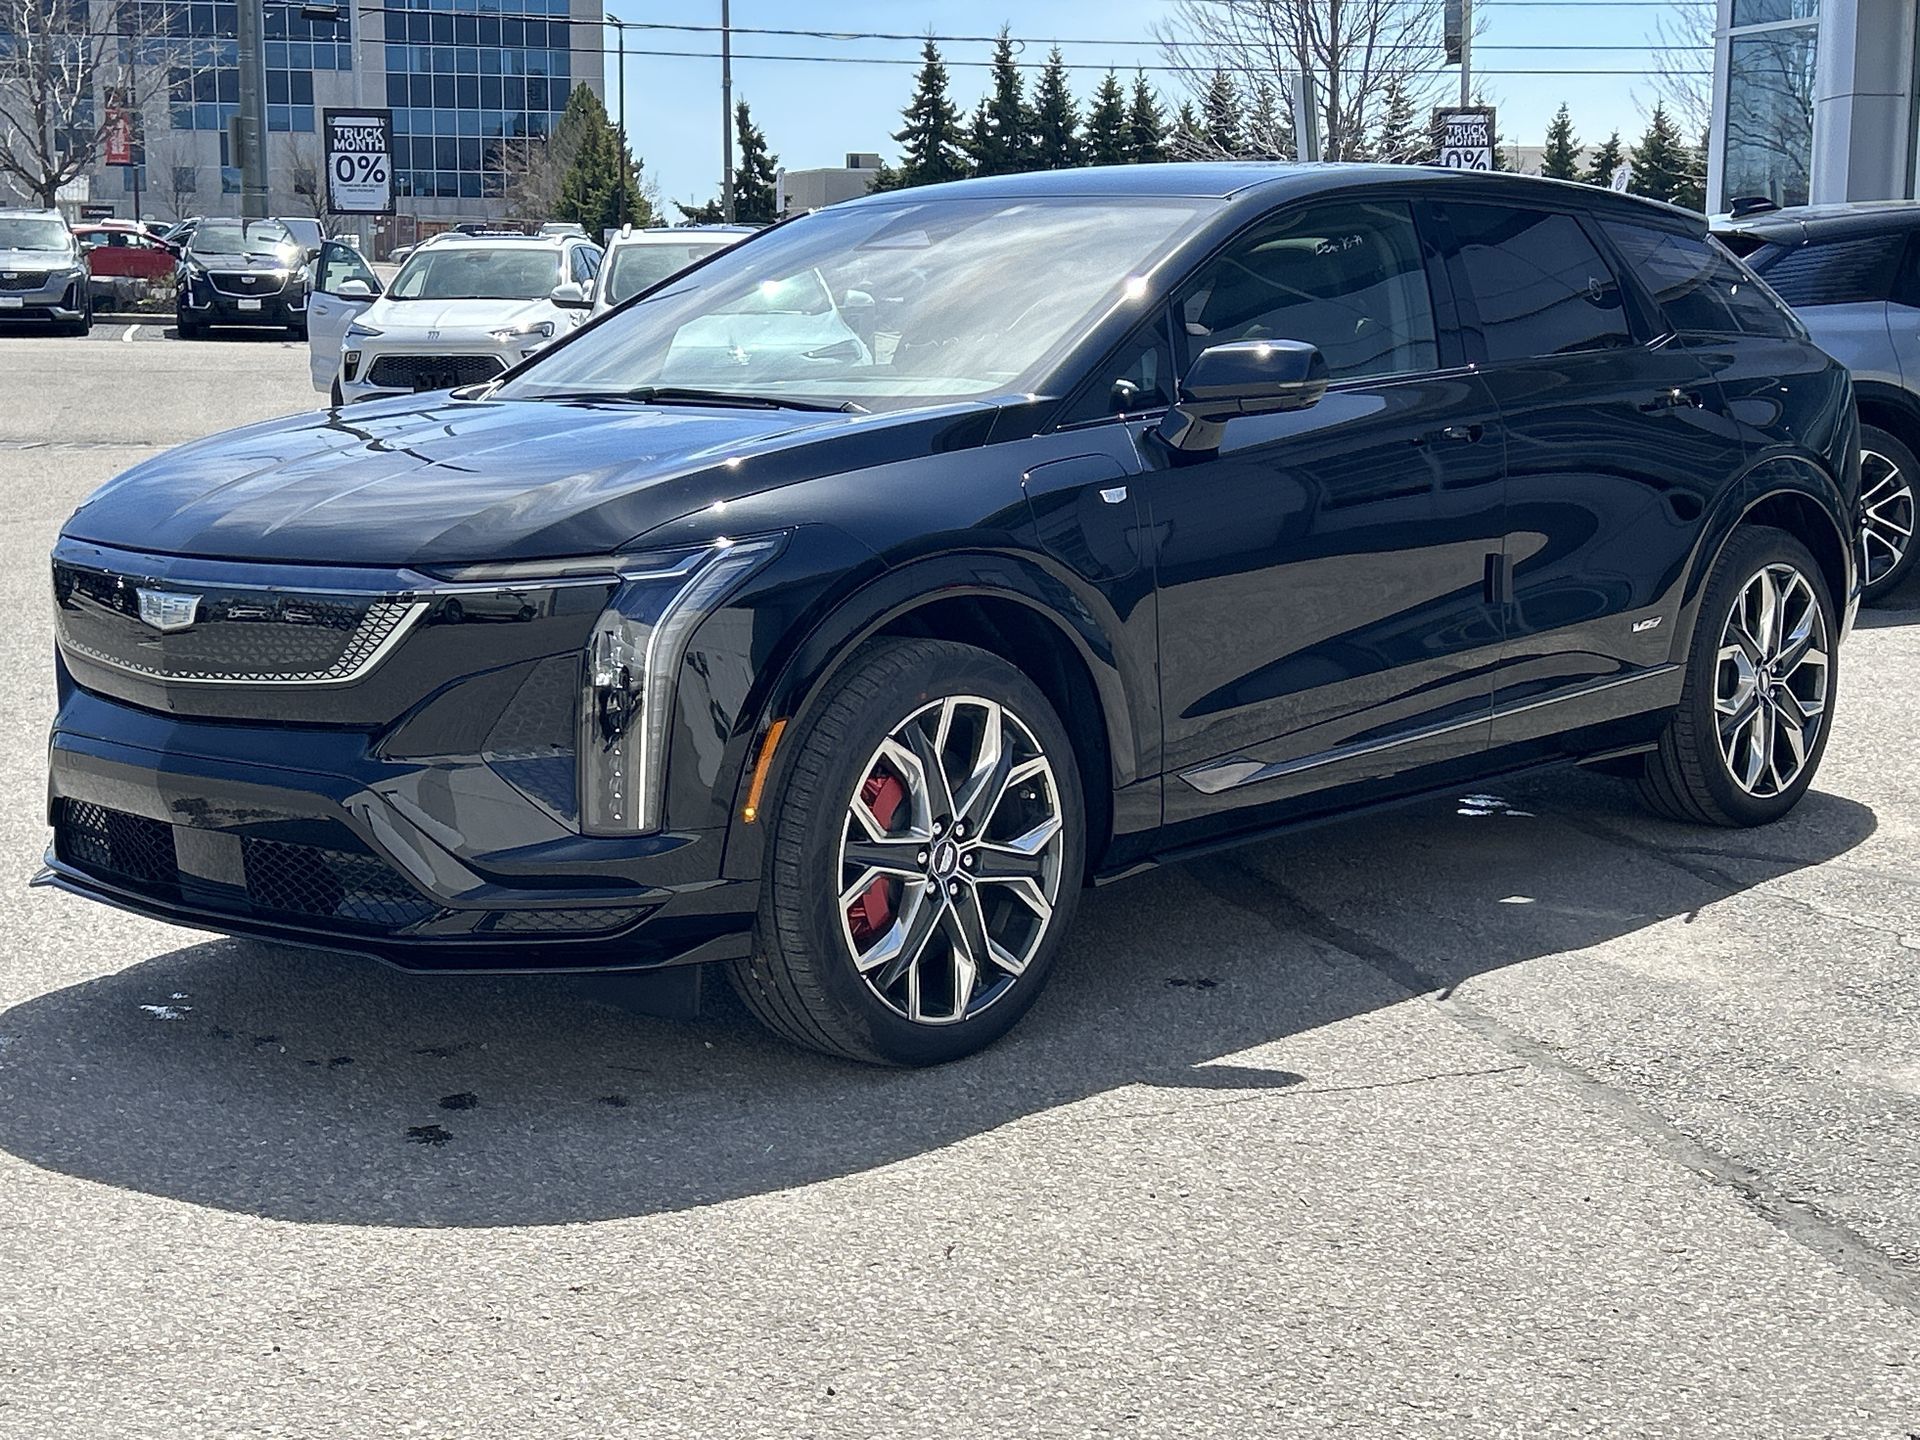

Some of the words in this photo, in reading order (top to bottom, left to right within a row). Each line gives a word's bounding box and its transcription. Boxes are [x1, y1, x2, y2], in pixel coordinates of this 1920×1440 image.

[334, 128, 383, 139] TRUCK
[1446, 124, 1487, 135] TRUCK
[333, 139, 386, 151] MONTH
[1445, 135, 1488, 146] MONTH
[1445, 150, 1487, 170] 0%
[336, 155, 386, 183] 0%
